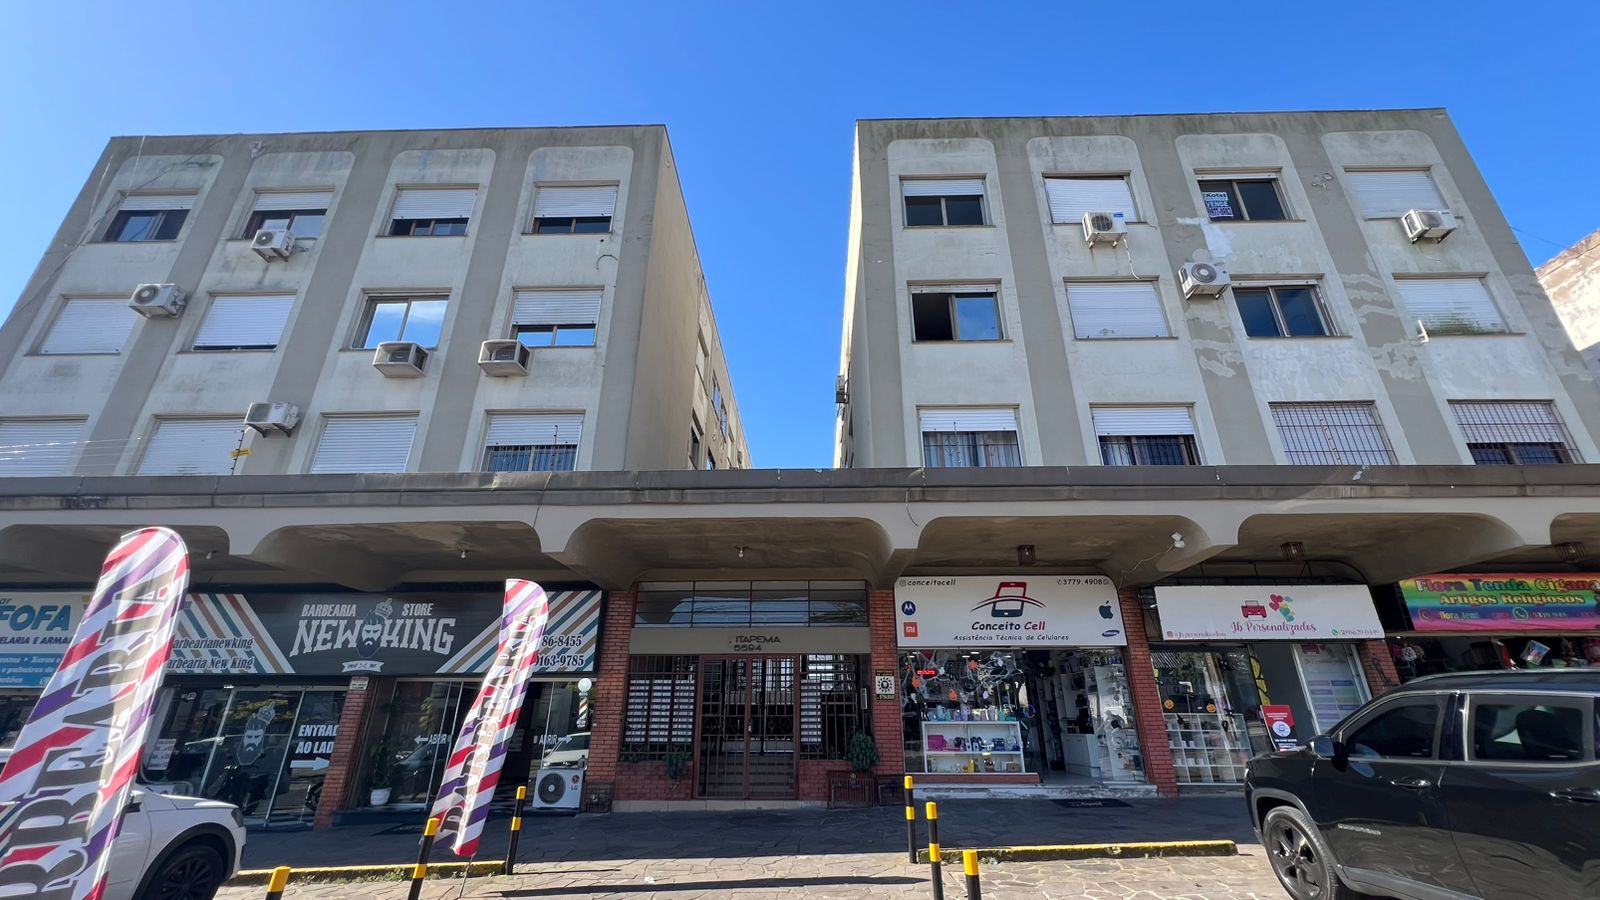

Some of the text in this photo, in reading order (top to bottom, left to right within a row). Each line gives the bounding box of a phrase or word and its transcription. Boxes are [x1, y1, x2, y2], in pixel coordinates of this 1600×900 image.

[1416, 578, 1600, 592] Flora Tenda Cigana
[1440, 594, 1586, 606] Artigos Religiosos
[301, 603, 434, 617] BARBEARIA STORE
[0, 605, 71, 631] FOFA
[971, 621, 1045, 631] Conceito Cell
[1246, 620, 1316, 636] Personalizados
[33, 636, 40, 645] E
[40, 636, 73, 645] ARMA
[173, 637, 254, 650] arbearianewking
[289, 618, 456, 657] NEW KING
[542, 635, 582, 647] 86-8455
[996, 633, 1022, 641] Técnica
[1036, 633, 1069, 641] Celulares
[167, 657, 253, 670] arbearia New King
[428, 734, 448, 745] ABRIR
[295, 741, 335, 754] AO LAD
